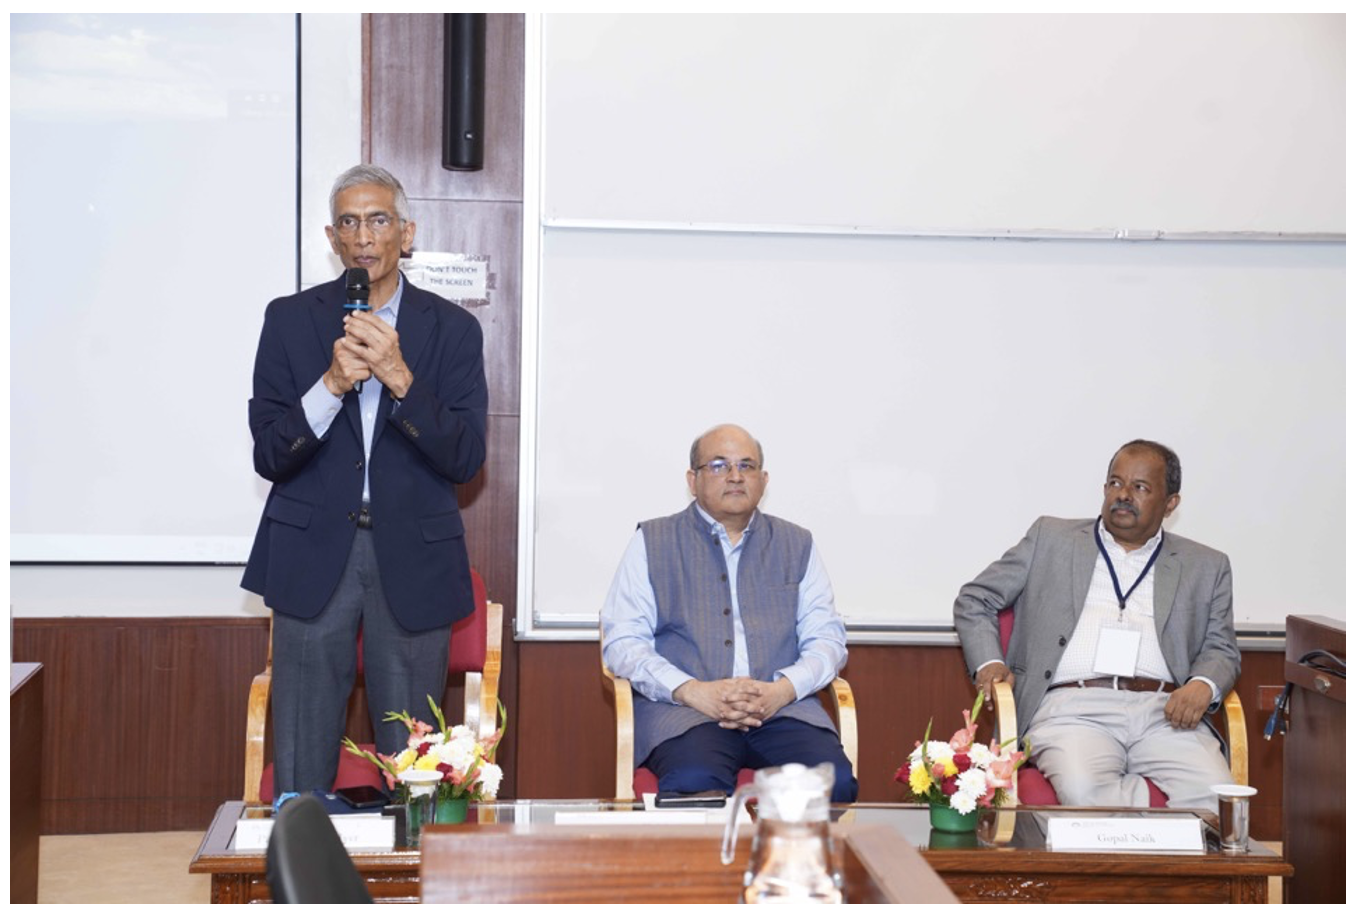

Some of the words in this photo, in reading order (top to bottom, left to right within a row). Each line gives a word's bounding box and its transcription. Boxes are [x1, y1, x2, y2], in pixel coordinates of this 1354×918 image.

[452, 265, 478, 275] TOUCH
[445, 278, 474, 286] SCREEN
[1097, 833, 1128, 845] Gopal
[1130, 833, 1156, 844] Naik
